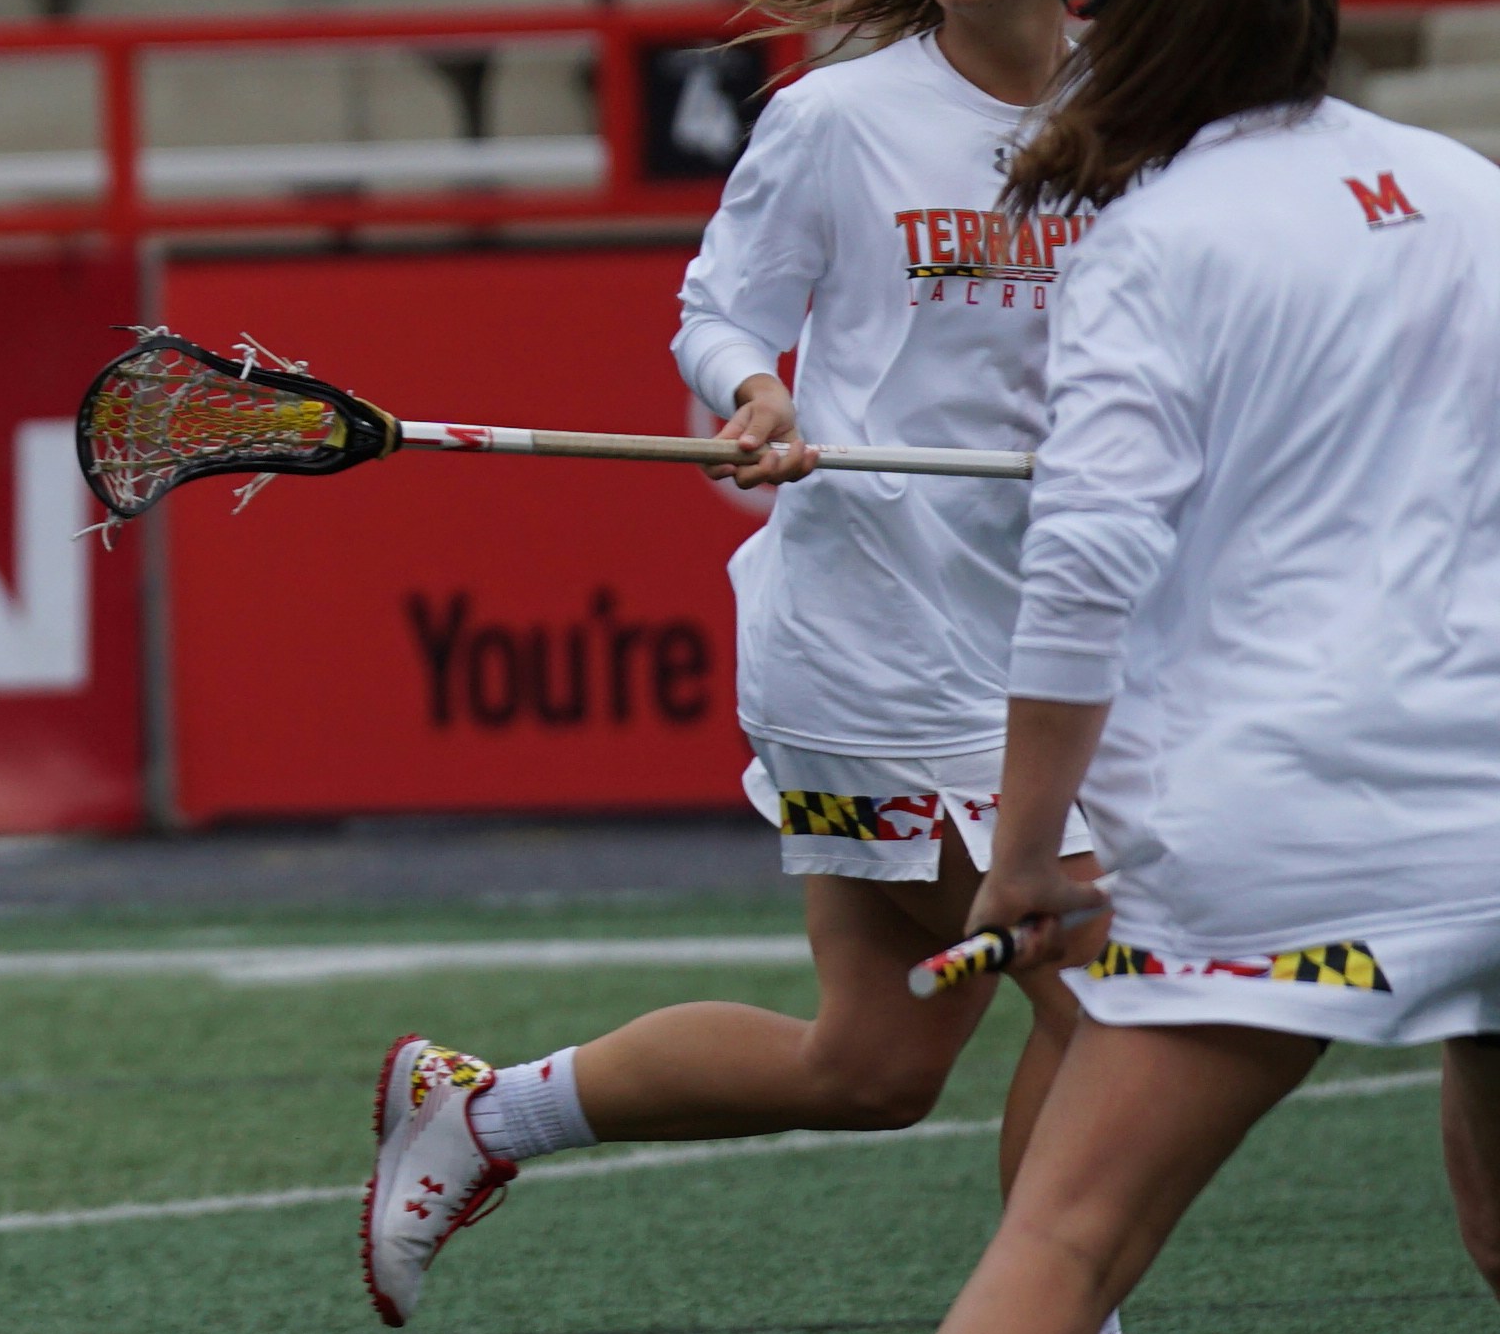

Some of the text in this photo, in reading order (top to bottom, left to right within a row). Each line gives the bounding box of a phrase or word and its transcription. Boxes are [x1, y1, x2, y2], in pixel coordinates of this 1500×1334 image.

[1342, 171, 1418, 223] M
[894, 208, 1096, 267] TERRAPI
[909, 279, 1048, 310] LACRO
[405, 582, 714, 730] You're
